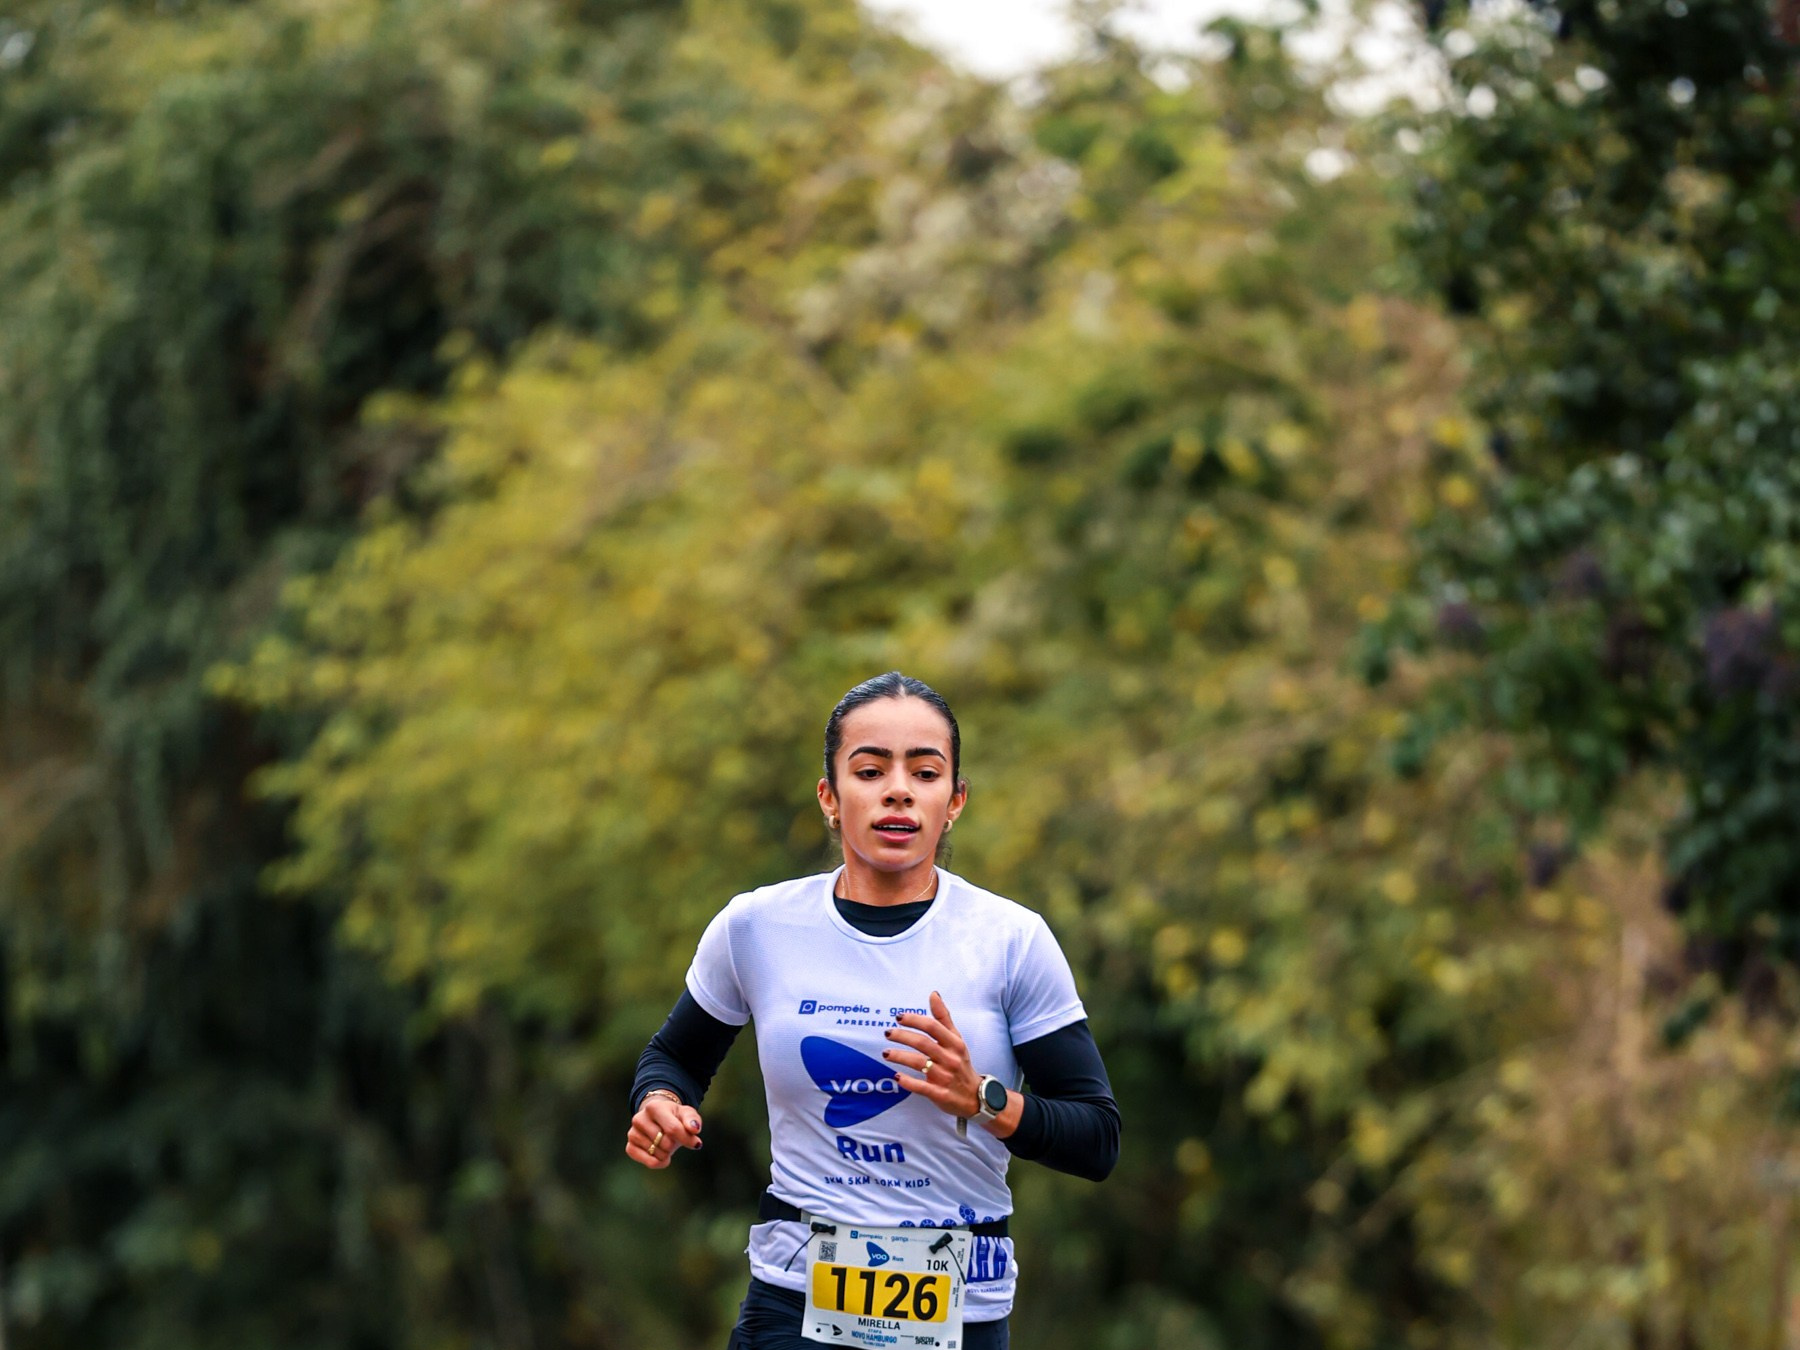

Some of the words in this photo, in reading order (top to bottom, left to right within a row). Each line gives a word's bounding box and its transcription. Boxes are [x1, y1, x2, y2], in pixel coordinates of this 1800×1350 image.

[818, 1000, 870, 1014] pompéia
[836, 1018, 898, 1028] APRESENTA
[836, 1135, 905, 1163] Run
[848, 1176, 870, 1185] 5KM
[905, 1178, 930, 1188] KIDS
[926, 1259, 949, 1272] 10K
[831, 1266, 938, 1321] 1126
[858, 1317, 901, 1331] MIRELLA
[866, 1333, 897, 1343] HAMBURGO
